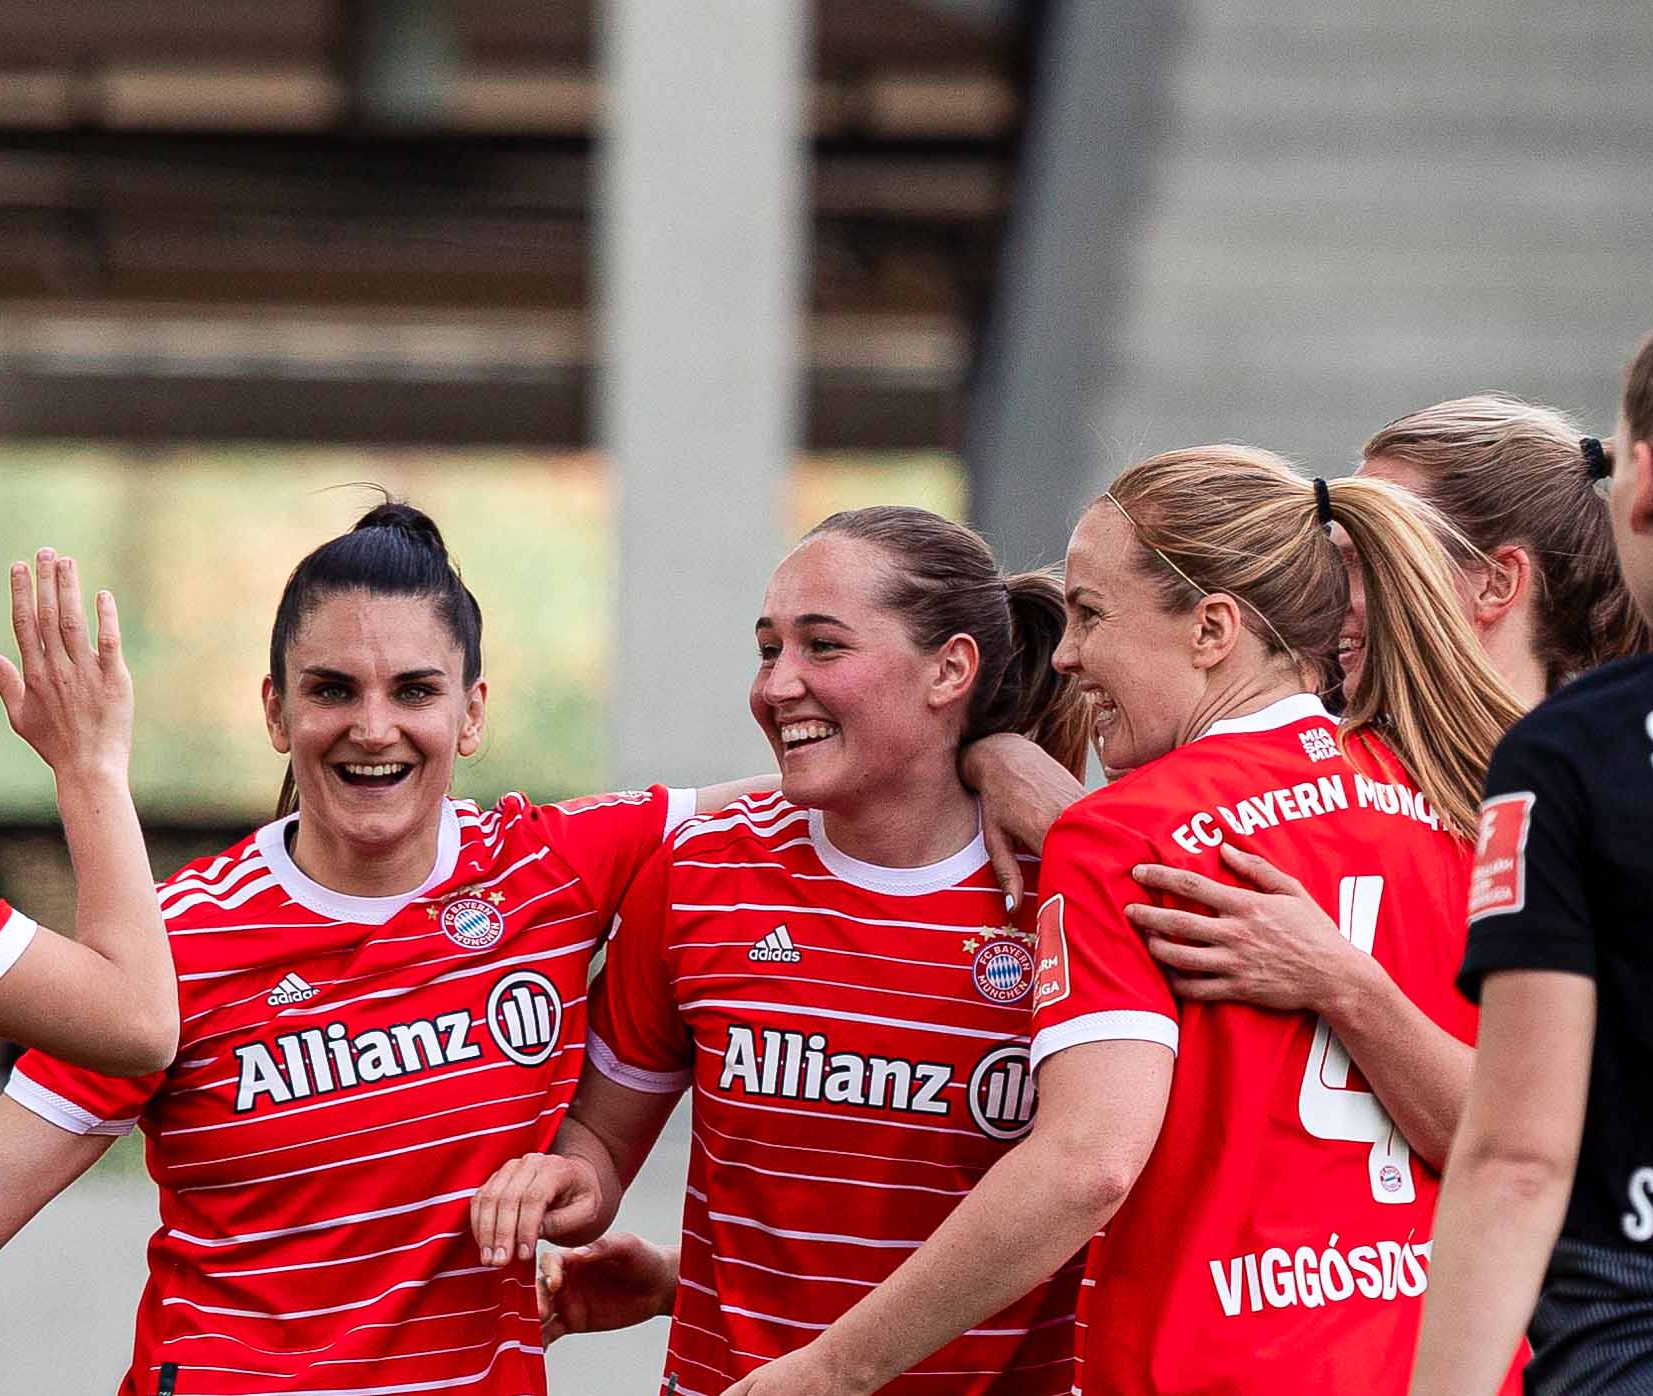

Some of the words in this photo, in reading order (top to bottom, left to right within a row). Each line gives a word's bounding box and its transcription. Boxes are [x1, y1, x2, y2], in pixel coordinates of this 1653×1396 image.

[1298, 727, 1330, 745] MIA
[1303, 736, 1336, 754] SAN
[1171, 811, 1223, 854] FC
[1217, 774, 1349, 837] BAYERN
[1353, 773, 1450, 832] MÜNC
[452, 902, 494, 916] BAYERN
[747, 948, 802, 963] adidas
[994, 945, 1031, 972] BAYERN
[234, 1010, 482, 1112] Allianz
[719, 1026, 954, 1115] Allianz
